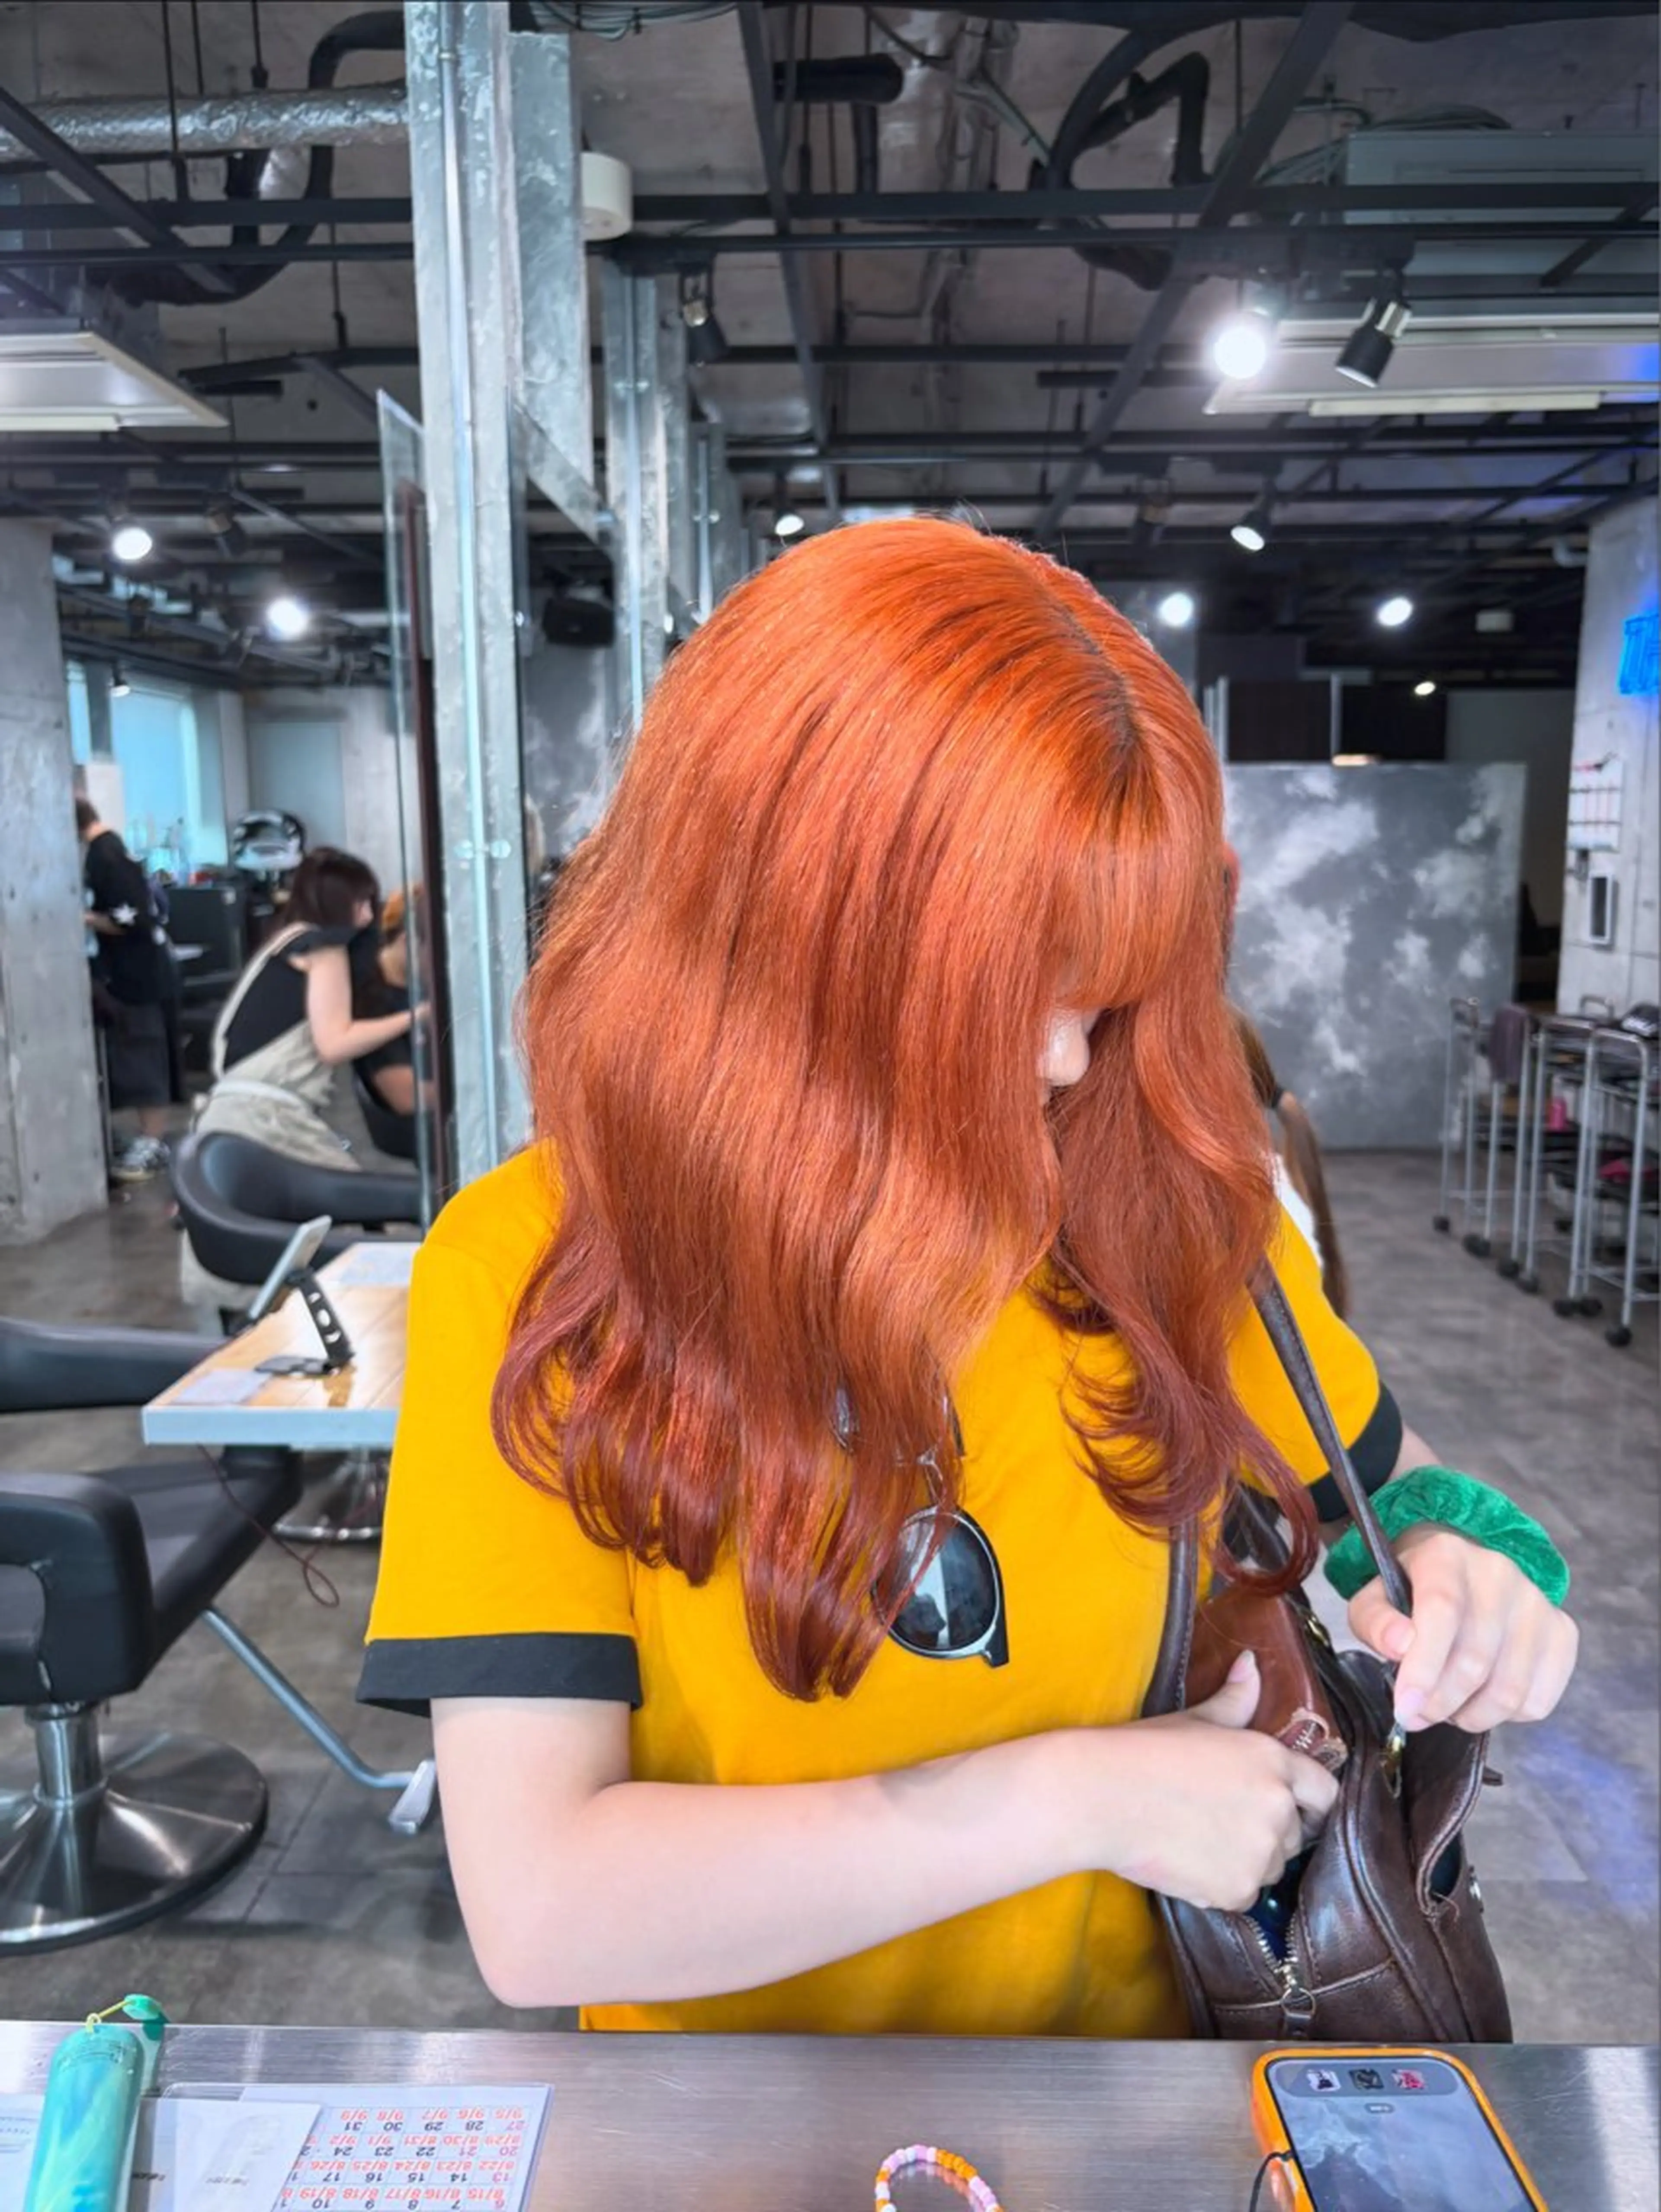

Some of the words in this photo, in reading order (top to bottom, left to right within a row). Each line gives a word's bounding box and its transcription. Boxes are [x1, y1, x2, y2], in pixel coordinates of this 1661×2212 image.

[422, 2109, 448, 2119] 9/7
[345, 2122, 362, 2131] 31
[383, 2122, 403, 2132] 30
[424, 2121, 444, 2131] 29
[465, 2121, 484, 2131] 28
[507, 2121, 525, 2131] 27
[404, 2135, 436, 2145] 8/31
[443, 2135, 478, 2145] 8/30
[334, 2146, 353, 2156] 24
[375, 2146, 394, 2156] 23
[416, 2146, 436, 2156] 22
[459, 2146, 477, 2156] 21
[499, 2146, 518, 2156] 20
[311, 2161, 345, 2170] 8/26
[353, 2161, 388, 2170] 8/25
[395, 2161, 430, 2170] 8/24
[323, 2172, 340, 2182] 17
[365, 2172, 383, 2183] 16
[408, 2172, 424, 2183] 15
[451, 2172, 467, 2182] 14
[493, 2172, 509, 2182] 13
[299, 2187, 336, 2199] 8/19
[343, 2188, 379, 2199] 8/18
[385, 2187, 420, 2199] 8/17
[424, 2188, 460, 2199] 8/16
[468, 2188, 503, 2199] 8/15
[312, 2197, 330, 2209] 10
[365, 2199, 374, 2210] 9
[407, 2199, 419, 2209] 8
[451, 2199, 461, 2210] 7
[496, 2198, 504, 2208] 6
